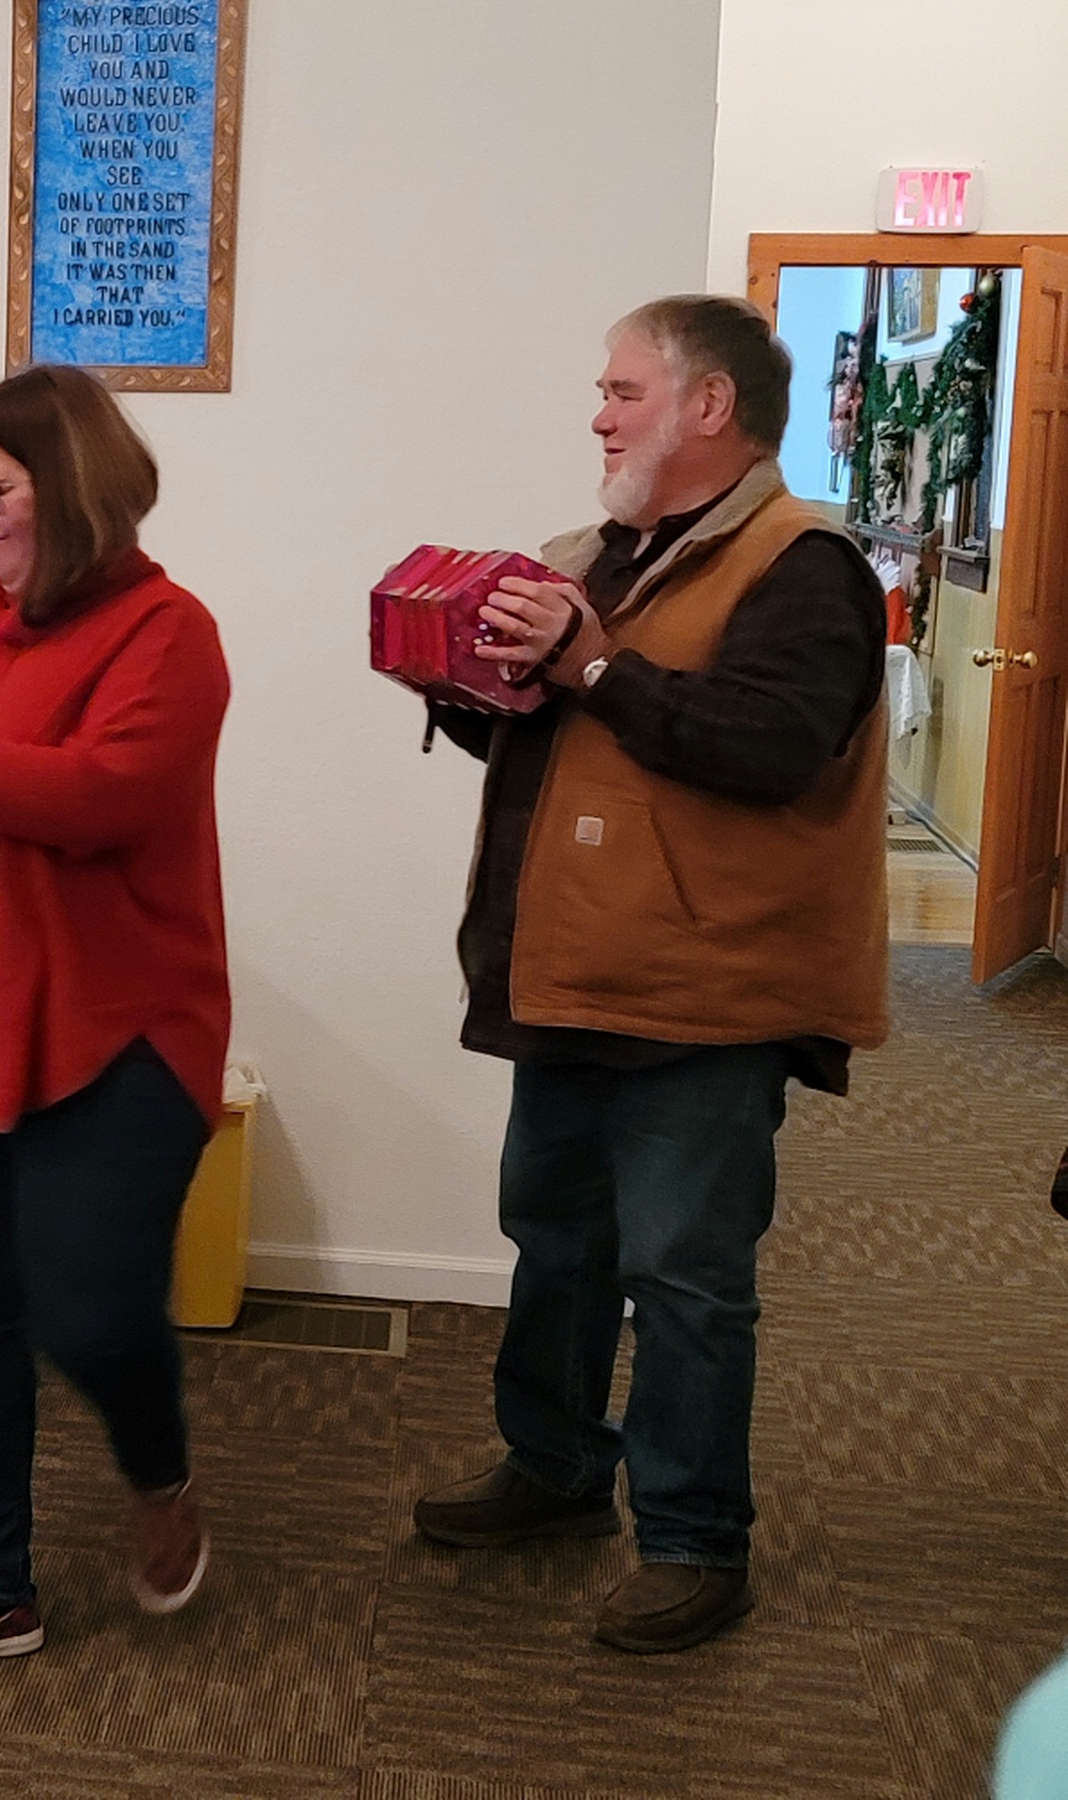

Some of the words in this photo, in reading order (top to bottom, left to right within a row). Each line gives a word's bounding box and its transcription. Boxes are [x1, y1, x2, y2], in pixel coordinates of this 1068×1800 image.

[110, 6, 199, 26] PRECIOUS
[68, 33, 123, 54] CHILD
[135, 34, 139, 53] I
[147, 33, 195, 53] LOVE
[89, 60, 123, 80] YOU
[131, 60, 170, 80] AND
[60, 87, 127, 107] WOULD
[133, 86, 196, 106] NEVER
[74, 112, 137, 133] LEAVE
[80, 139, 134, 160] WHEN
[143, 139, 178, 160] YOU
[106, 165, 142, 186] SEE
[58, 192, 105, 212] ONLY
[112, 192, 149, 212] ONE
[153, 192, 190, 212] SET
[893, 171, 972, 227] EXIT
[60, 217, 80, 235] OF
[86, 217, 186, 236] FOOTPRINTS
[70, 241, 86, 257] IN
[92, 241, 125, 258] THE
[128, 241, 175, 258] SAND
[67, 263, 83, 280] IT
[89, 263, 127, 281] WAS
[131, 263, 175, 280] THEN
[96, 286, 144, 304] THAT
[54, 308, 58, 324] I
[64, 308, 133, 327] CARRIED
